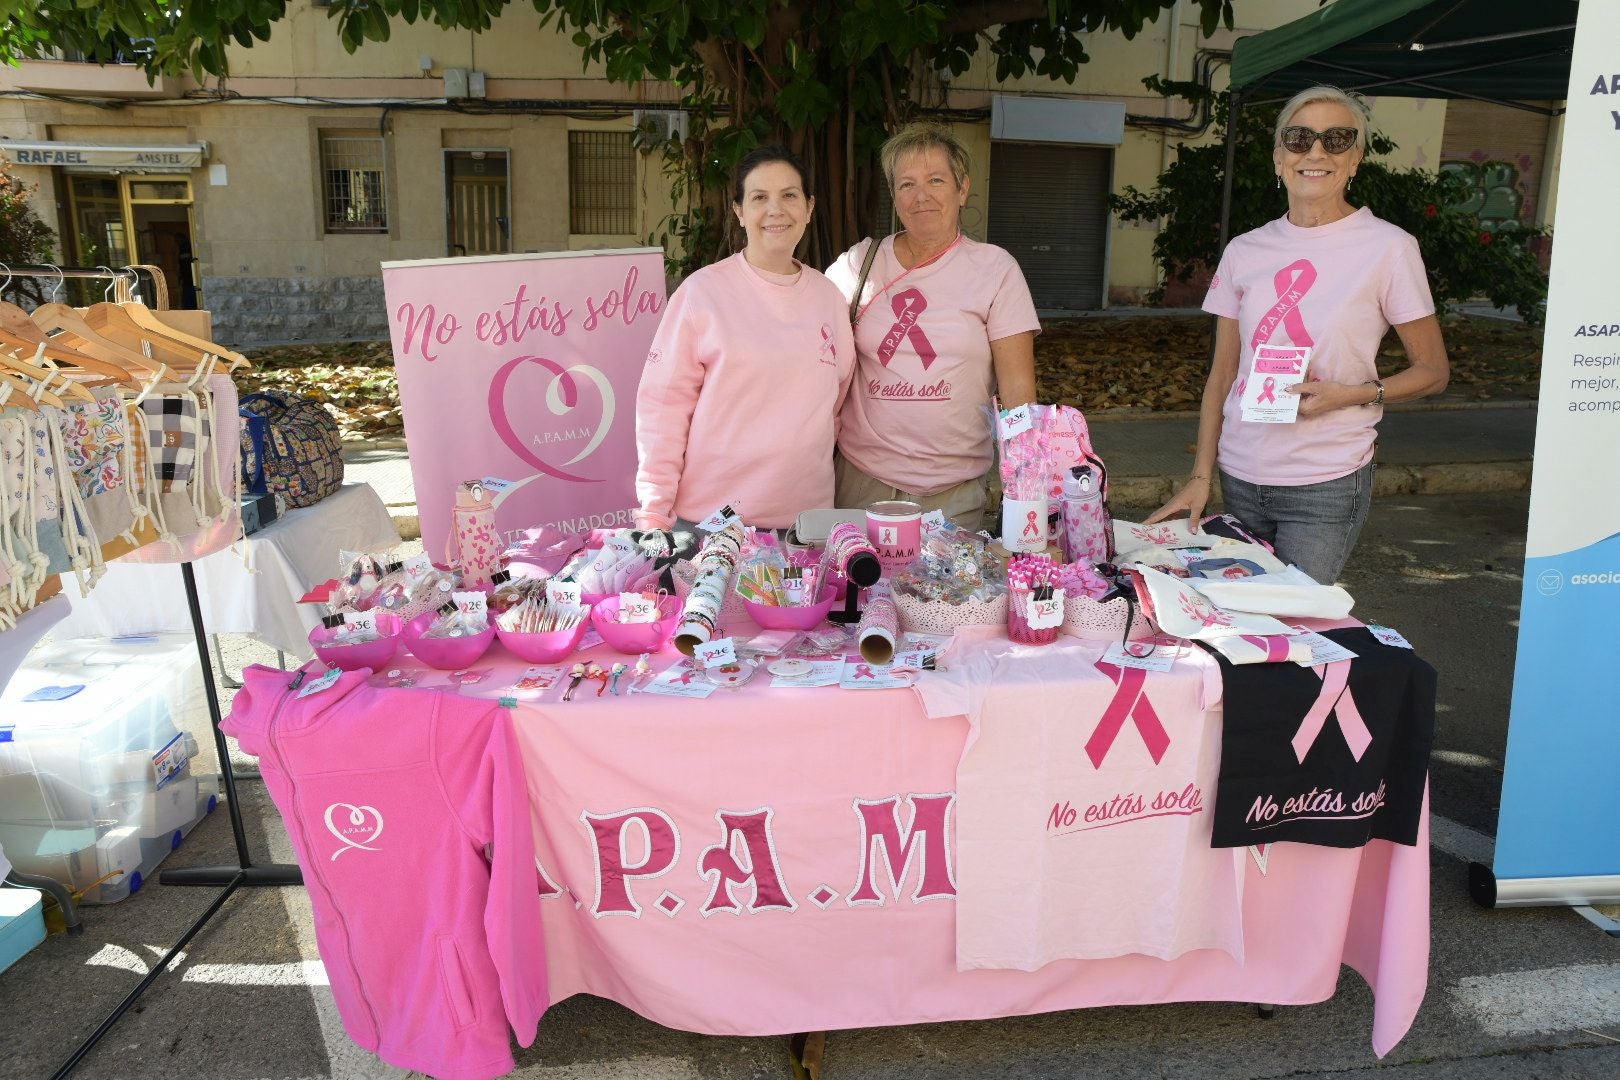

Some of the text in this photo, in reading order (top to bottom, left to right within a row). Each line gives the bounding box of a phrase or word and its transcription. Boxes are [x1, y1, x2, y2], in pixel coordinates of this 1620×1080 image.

[17, 150, 182, 164] RAFAEL AMSTEL
[397, 265, 664, 362] No estás sola
[1574, 324, 1620, 337] ASAP
[881, 380, 916, 397] estás
[1571, 376, 1619, 392] mejor,
[1568, 400, 1620, 414] acomp
[532, 427, 591, 446] A.P.A.M.M
[562, 591, 576, 601] 3€
[468, 601, 482, 610] 2€
[635, 604, 651, 614] 3€
[1045, 602, 1059, 612] 2€
[355, 620, 371, 630] 3€
[1047, 800, 1077, 831] No
[1084, 792, 1147, 823] estás
[1245, 794, 1279, 824] No
[1283, 787, 1347, 815] estás
